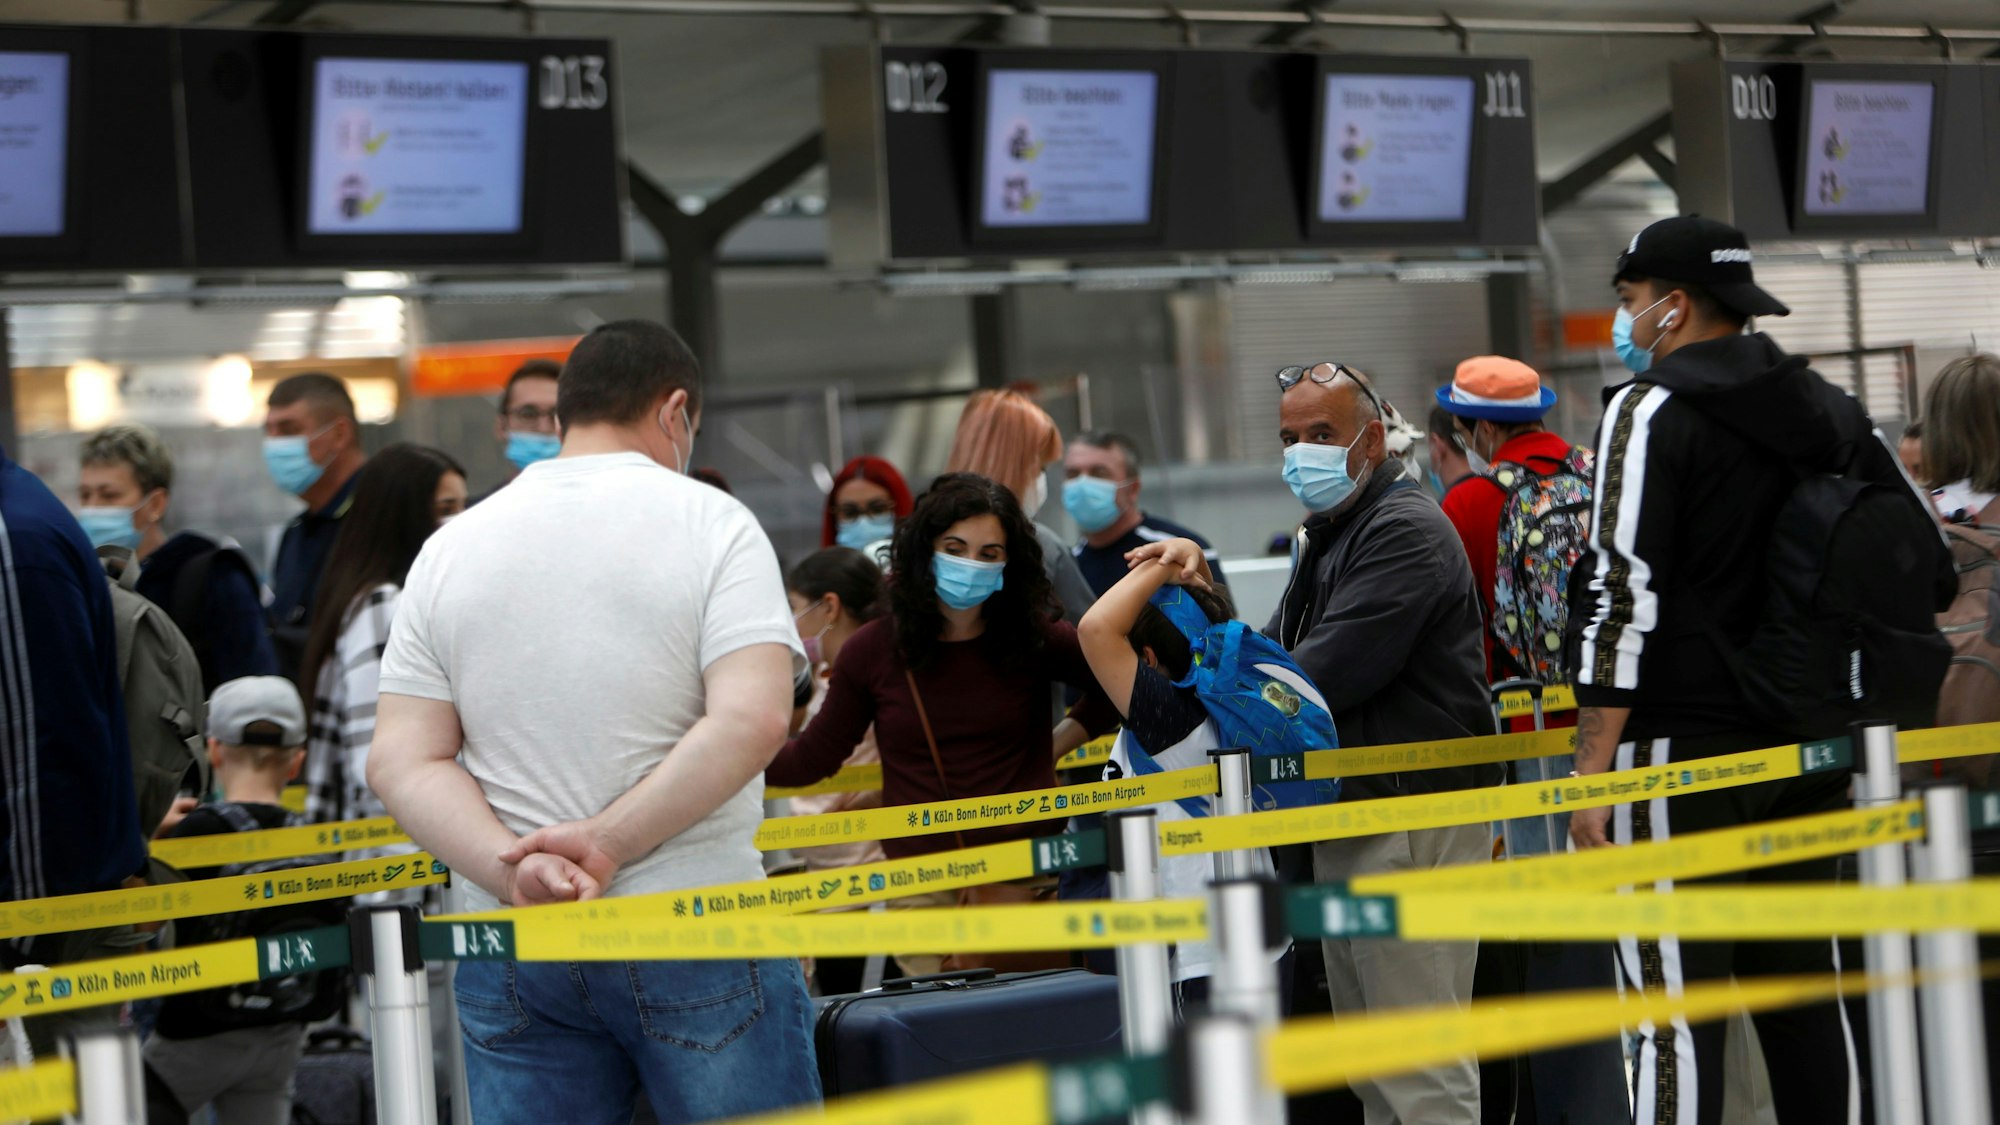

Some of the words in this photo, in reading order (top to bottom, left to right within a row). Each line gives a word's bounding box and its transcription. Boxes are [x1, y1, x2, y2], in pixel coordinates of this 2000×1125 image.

[540, 55, 608, 109] D13
[885, 61, 949, 113] D12
[1731, 75, 1777, 120] D10
[1071, 793, 1089, 806] Köln
[1093, 790, 1112, 803] Bonn
[1115, 784, 1146, 801] Airport
[934, 810, 953, 824] Köln
[957, 808, 977, 821] Bonn
[980, 803, 1012, 819] Airport
[1166, 830, 1203, 848] Airport
[278, 880, 302, 896] Köln
[306, 877, 334, 892] Bonn
[337, 869, 378, 888] Airport
[890, 870, 914, 887] Köln
[917, 867, 944, 884] Bonn
[947, 859, 988, 879] Airport
[708, 896, 735, 913] Köln
[738, 893, 766, 910] Bonn
[770, 885, 813, 906] Airport
[78, 976, 108, 995] Köln
[113, 970, 146, 989] Bonn
[152, 960, 201, 985] Airport
